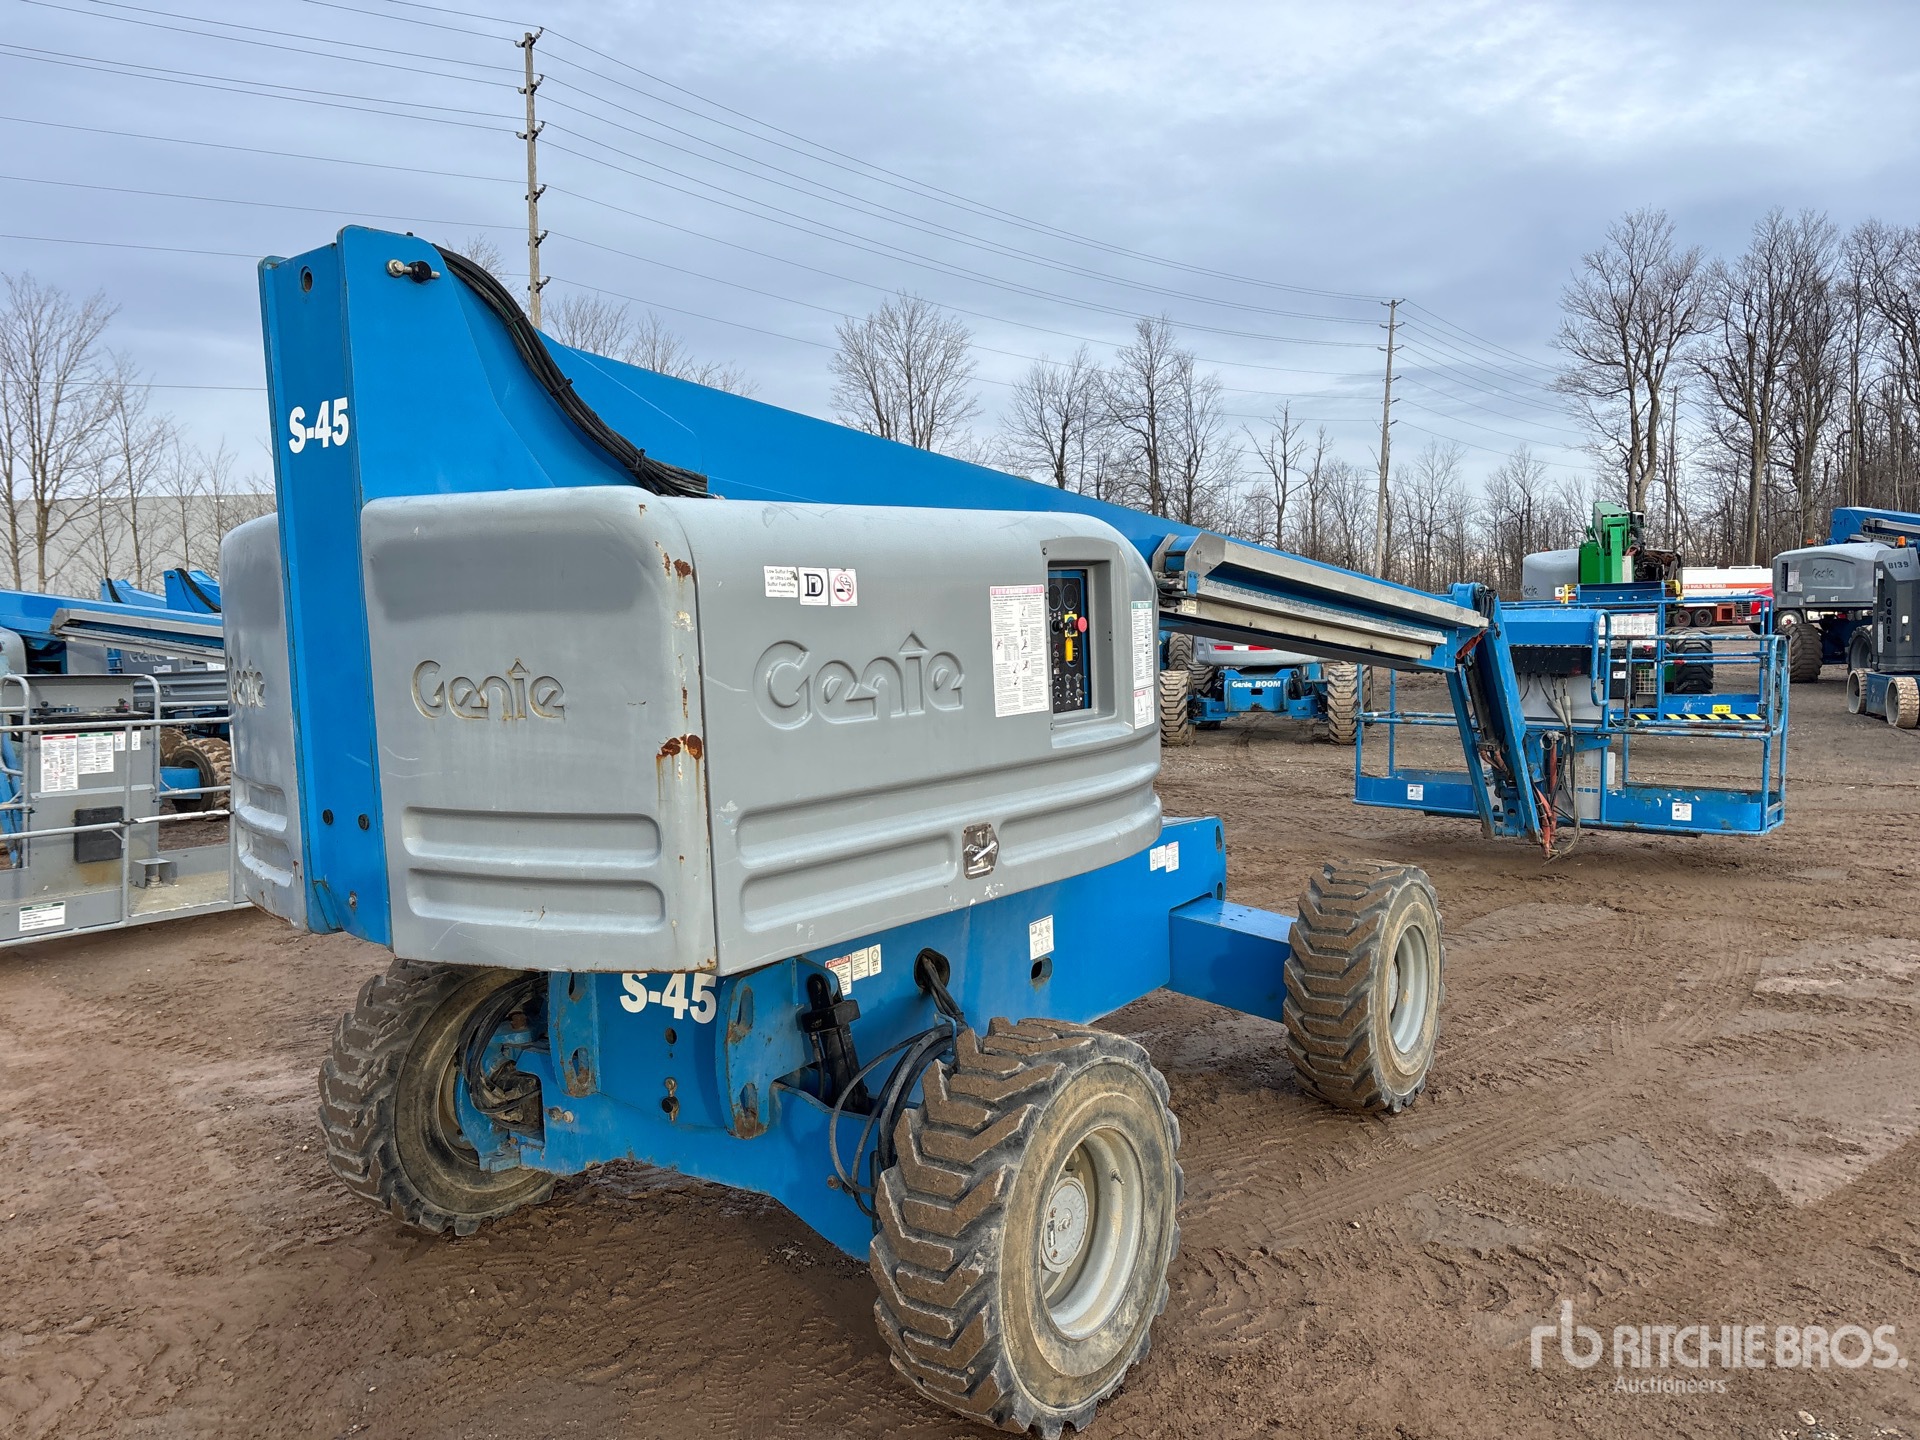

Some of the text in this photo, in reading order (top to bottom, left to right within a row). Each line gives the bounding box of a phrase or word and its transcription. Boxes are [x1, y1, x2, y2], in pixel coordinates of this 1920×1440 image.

[289, 397, 349, 454] S-45
[1888, 560, 1910, 569] B139
[1885, 597, 1893, 643] Genie
[411, 657, 566, 721] Genie
[753, 631, 965, 730] Genie
[1255, 680, 1281, 688] BOOM
[620, 972, 717, 1024] S-45
